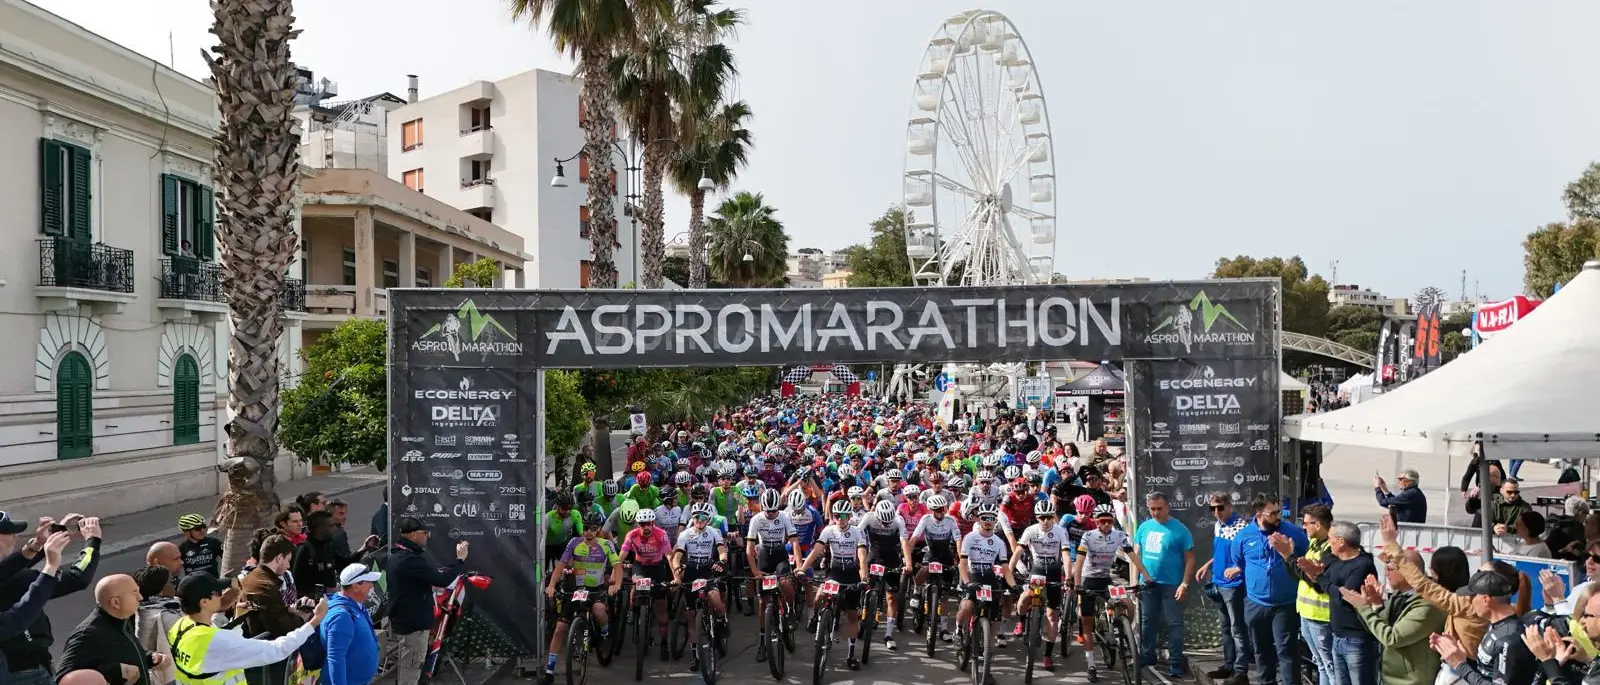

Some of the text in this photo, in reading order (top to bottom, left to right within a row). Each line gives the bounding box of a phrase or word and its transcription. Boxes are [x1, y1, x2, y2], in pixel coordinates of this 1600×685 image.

[546, 297, 1121, 356] ASPROMARATHON
[1144, 333, 1254, 343] ASPRO MARATHON
[412, 341, 522, 352] ASPRO MARATHON
[1160, 377, 1257, 389] ECOENERGY
[415, 391, 512, 399] ECOENERGY
[1176, 394, 1240, 414] DELTA
[432, 406, 496, 426] DELTA
[454, 503, 477, 517] CALA
